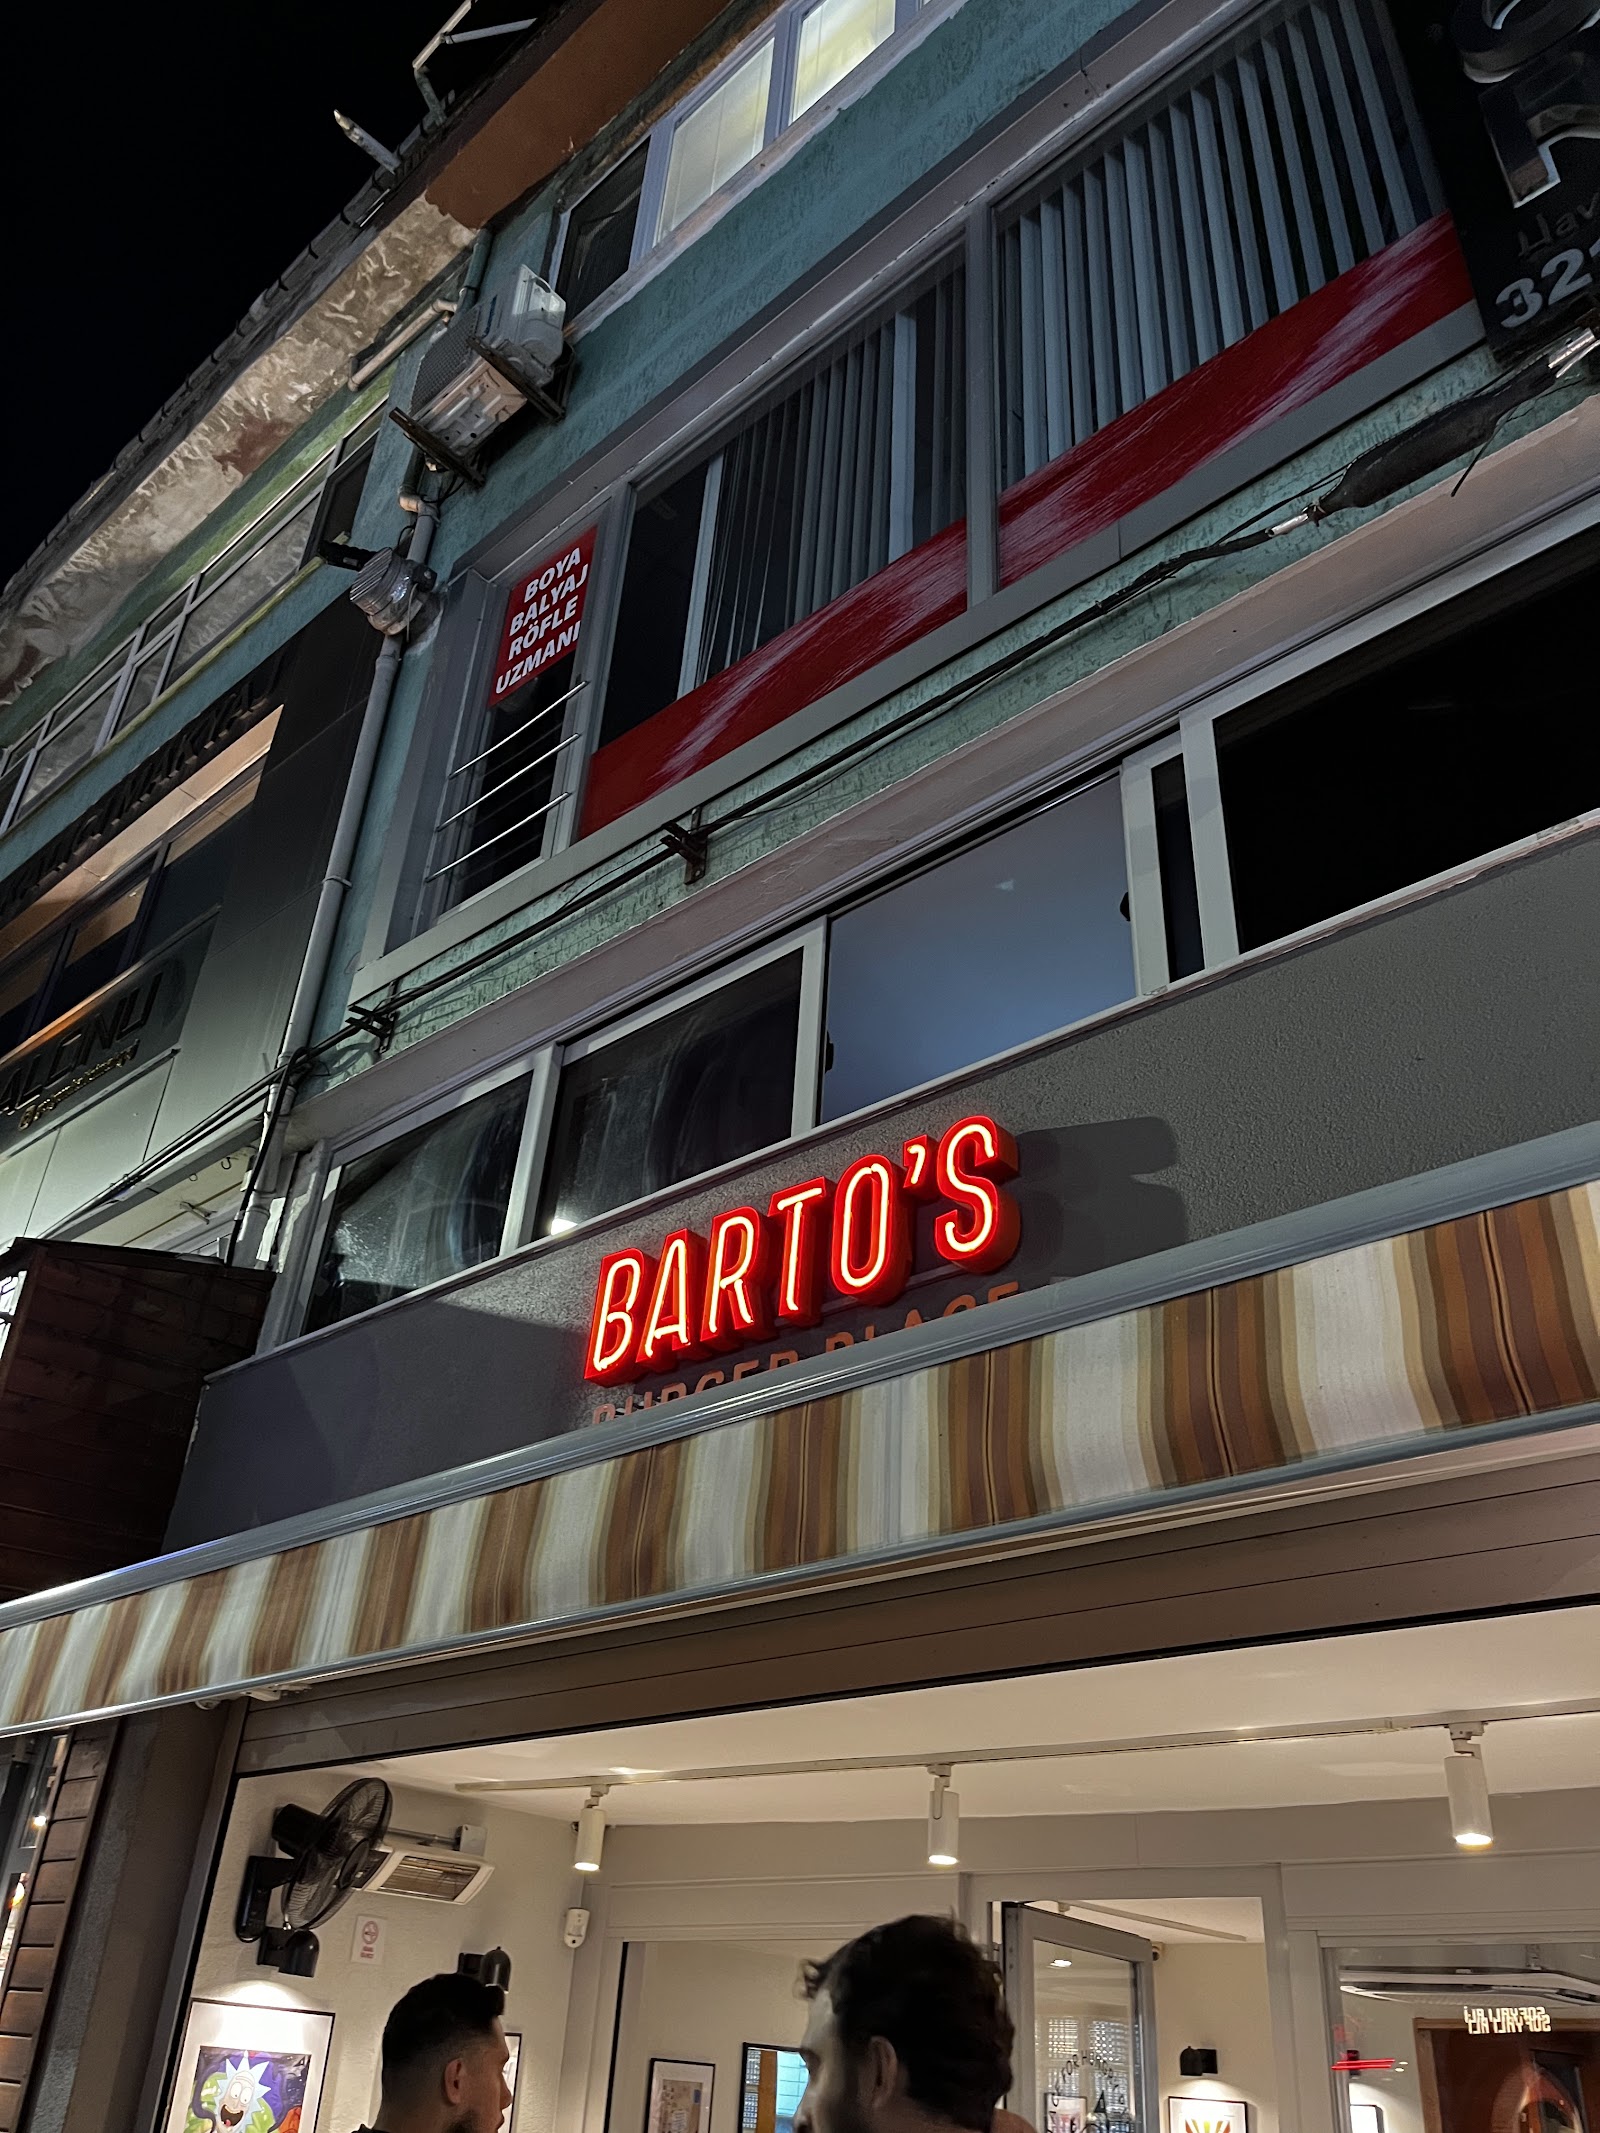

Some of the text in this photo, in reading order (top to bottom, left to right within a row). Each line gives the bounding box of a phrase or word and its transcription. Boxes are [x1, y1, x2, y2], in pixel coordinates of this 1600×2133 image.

[1495, 239, 1600, 328] 32
[509, 563, 589, 637] BALYAJ
[524, 547, 581, 603] BOYA
[495, 620, 582, 694] UZMANI
[508, 595, 579, 661] RÖFLE
[583, 1115, 1020, 1387] BARTO'S
